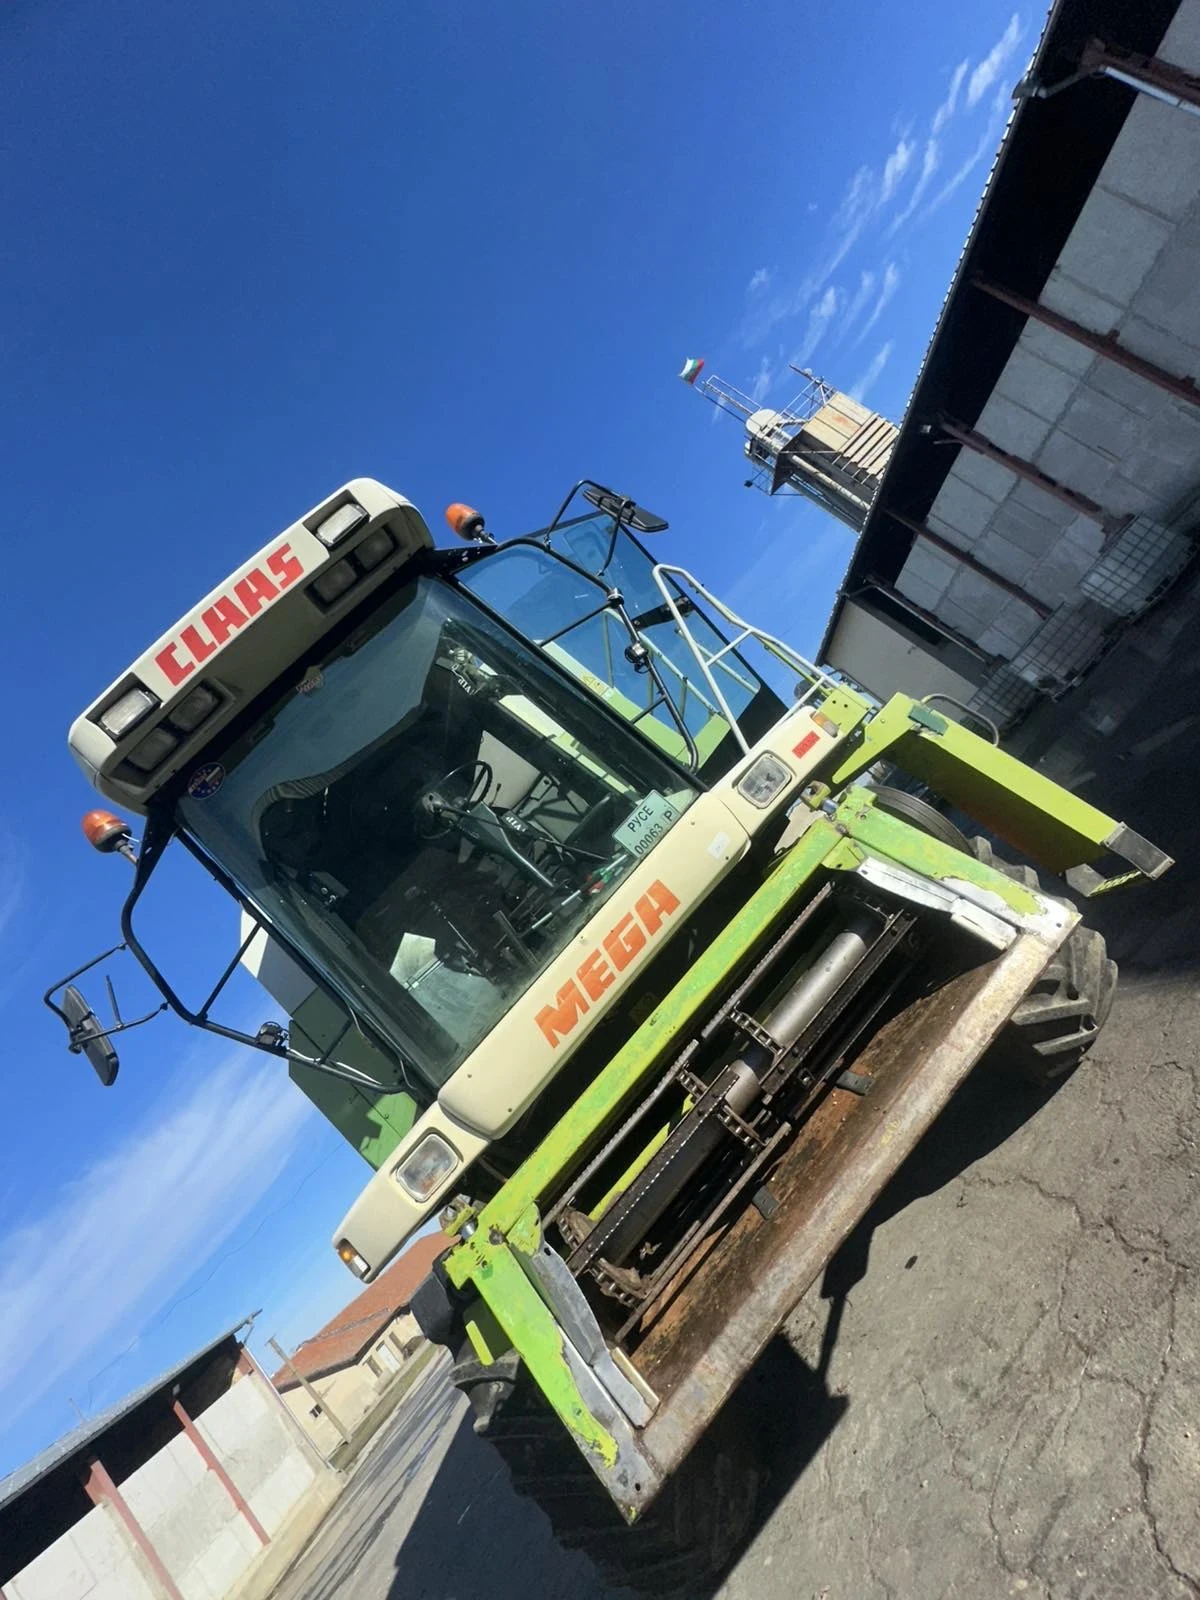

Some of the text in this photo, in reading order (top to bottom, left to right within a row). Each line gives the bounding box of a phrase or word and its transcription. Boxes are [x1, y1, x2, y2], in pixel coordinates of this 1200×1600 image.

[154, 543, 304, 687] CLAAS
[627, 805, 654, 832] РУСЕ
[634, 823, 663, 855] 00063
[534, 879, 681, 1049] MEGA
